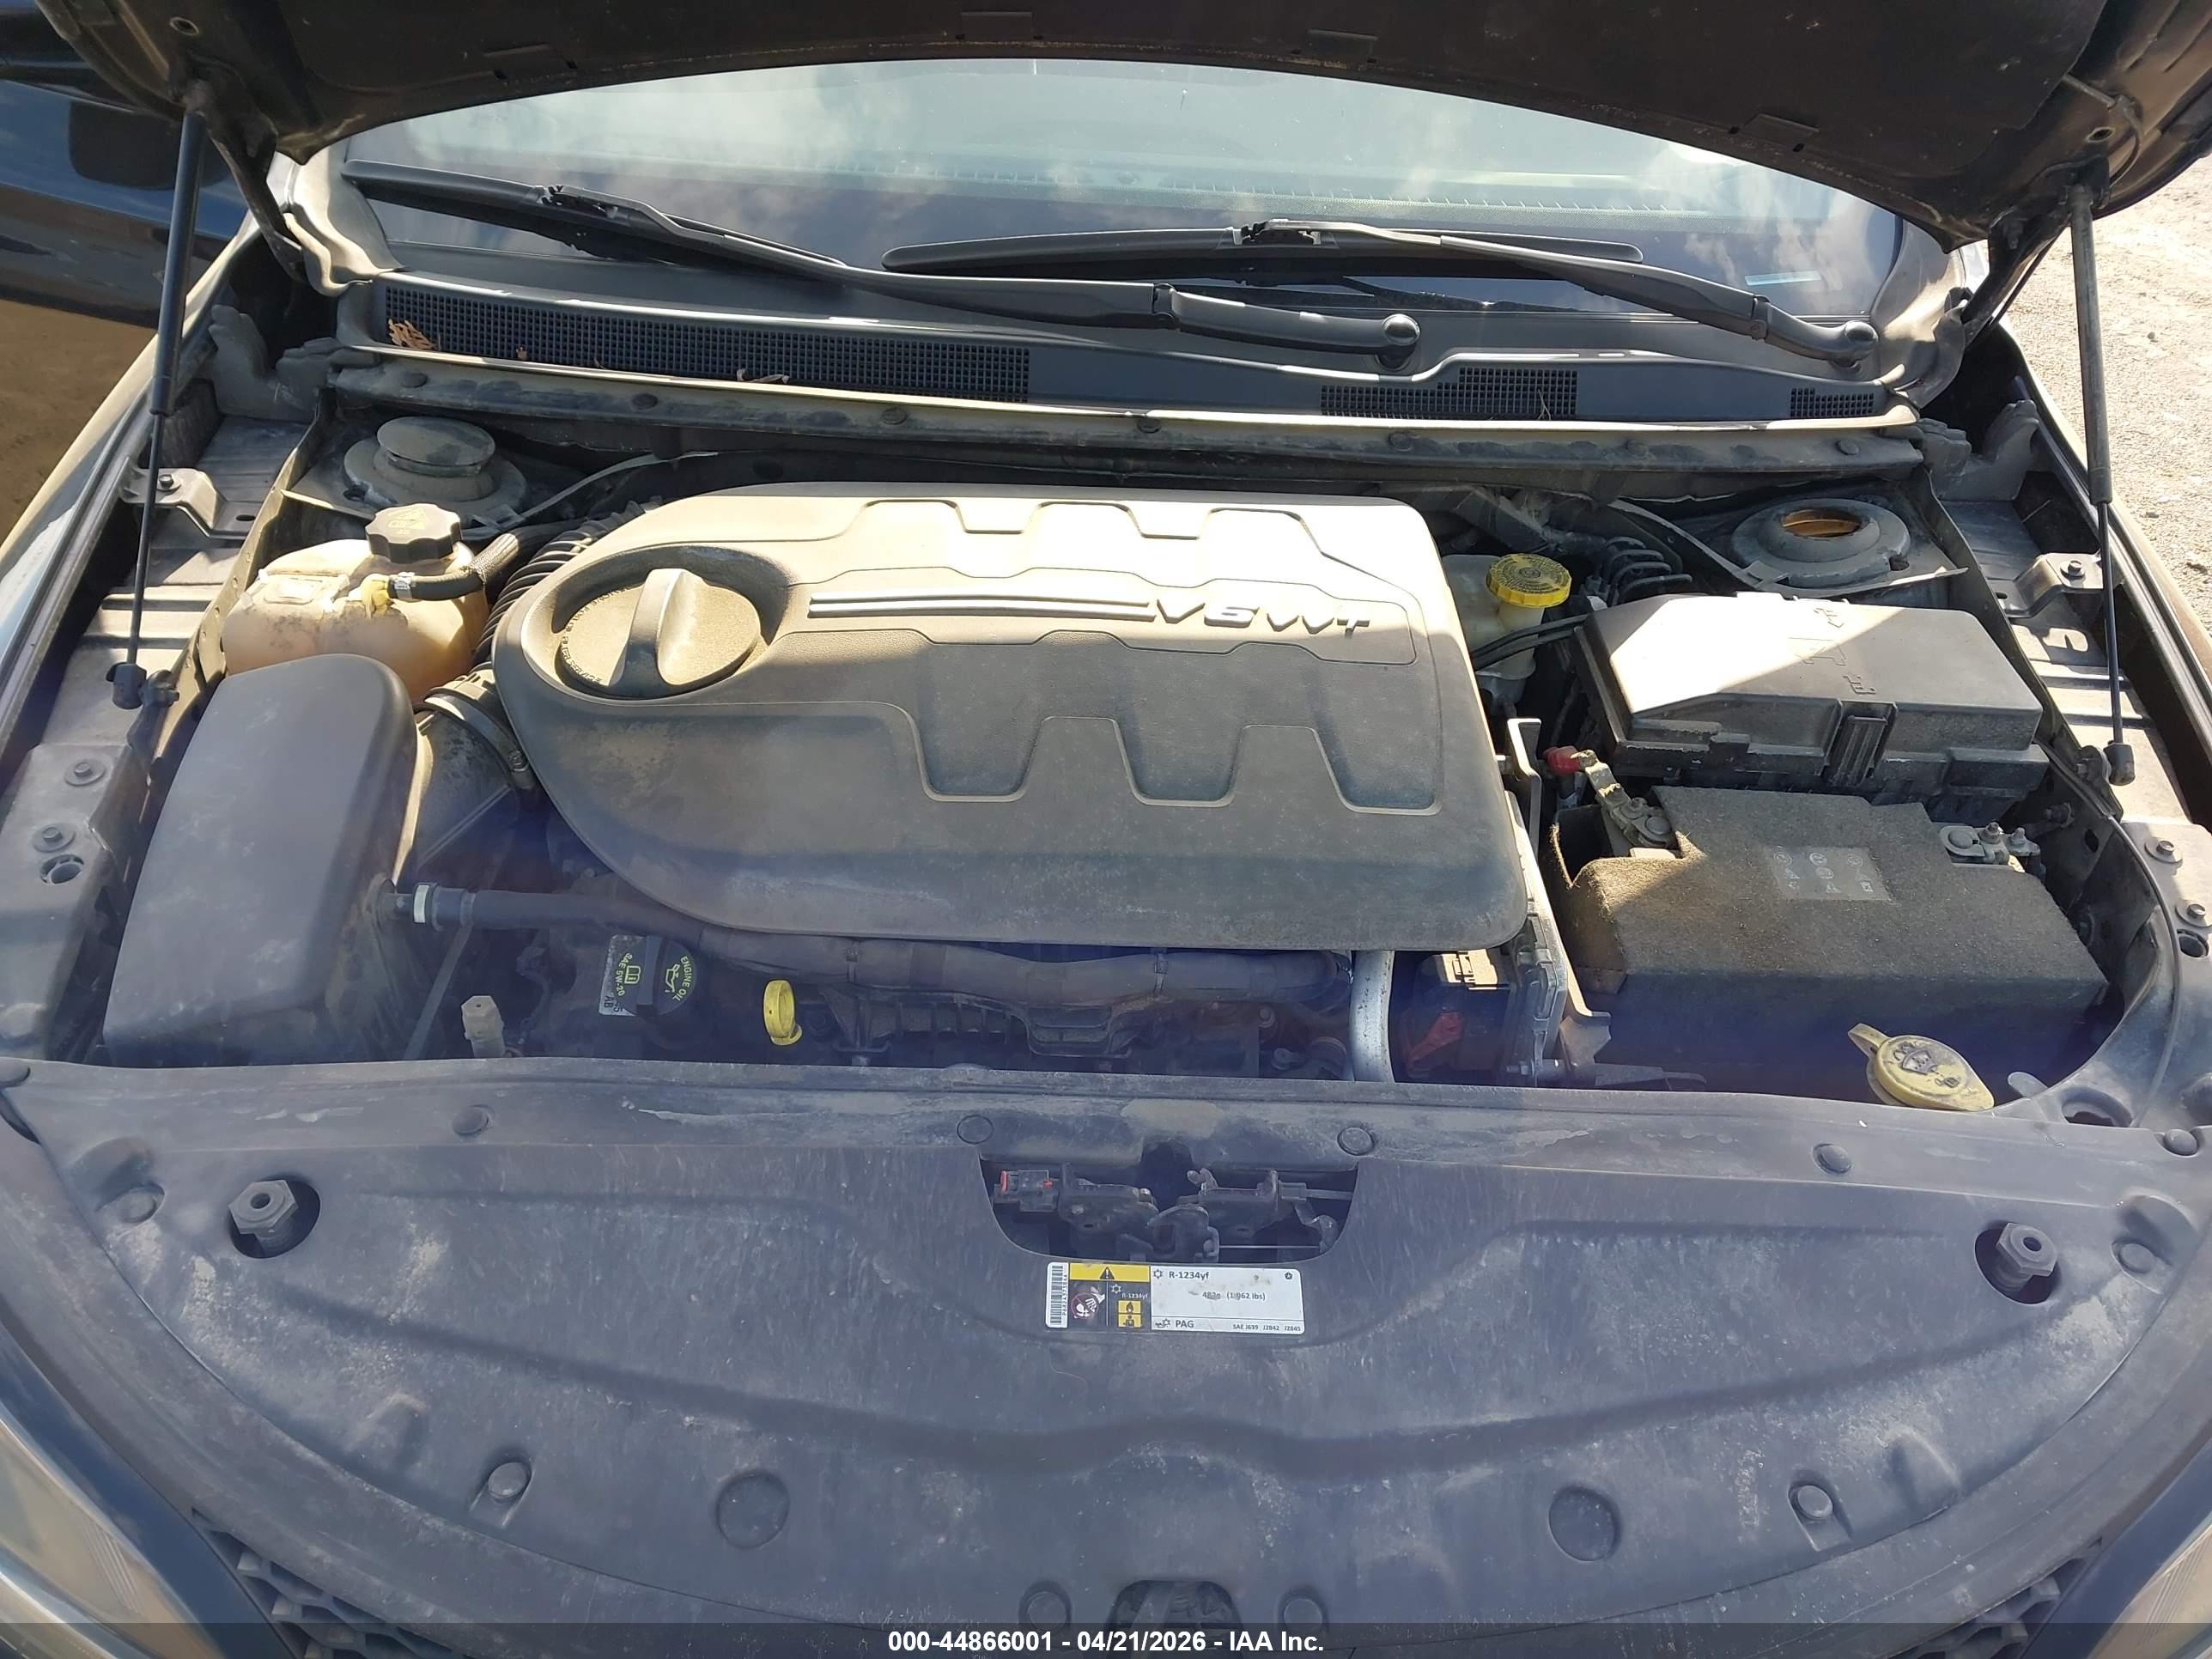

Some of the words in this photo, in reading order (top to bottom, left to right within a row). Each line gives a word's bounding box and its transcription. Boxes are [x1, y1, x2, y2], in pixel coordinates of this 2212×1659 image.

[617, 952, 633, 969] SAE
[680, 955, 692, 988] ENGINE
[614, 969, 626, 997] 5W-20
[672, 988, 687, 1002] OIL
[1169, 1270, 1209, 1281] R-1234yf
[1251, 1291, 1267, 1301] lbs)
[1175, 1320, 1194, 1329] PAG
